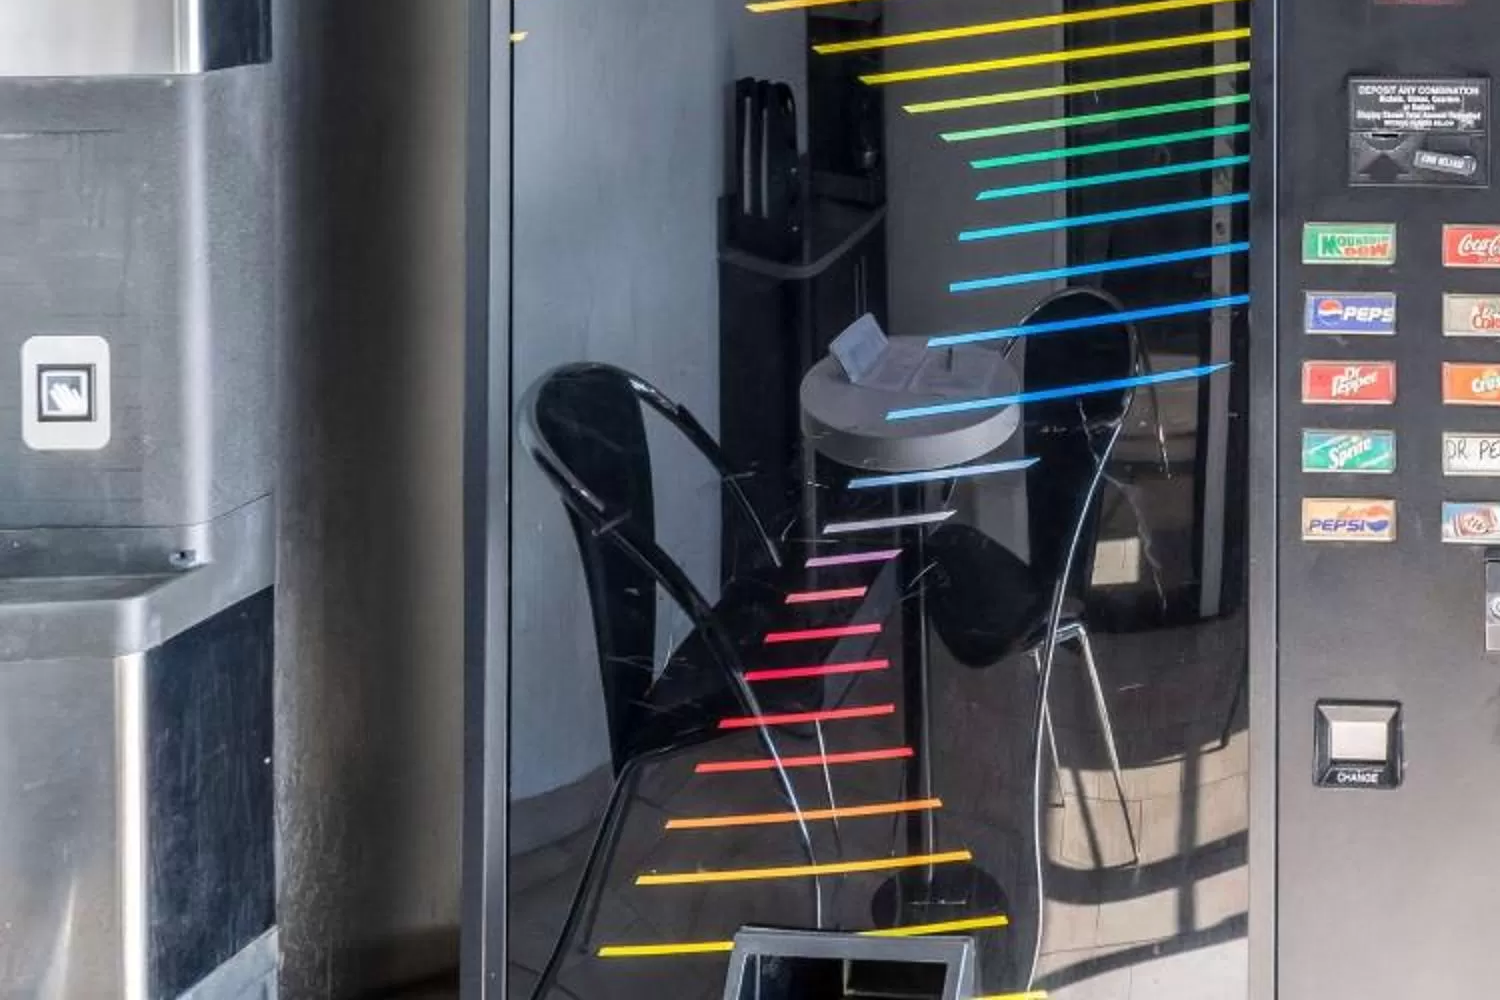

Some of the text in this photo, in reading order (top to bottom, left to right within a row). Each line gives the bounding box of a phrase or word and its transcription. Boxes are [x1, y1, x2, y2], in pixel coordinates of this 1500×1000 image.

[1358, 85, 1479, 95] DEPOSIT ANY COMBINATION
[1343, 306, 1394, 323] PEPS
[1446, 440, 1468, 459] DR
[1309, 519, 1365, 532] PEPSI
[1337, 773, 1379, 783] CHANGE
